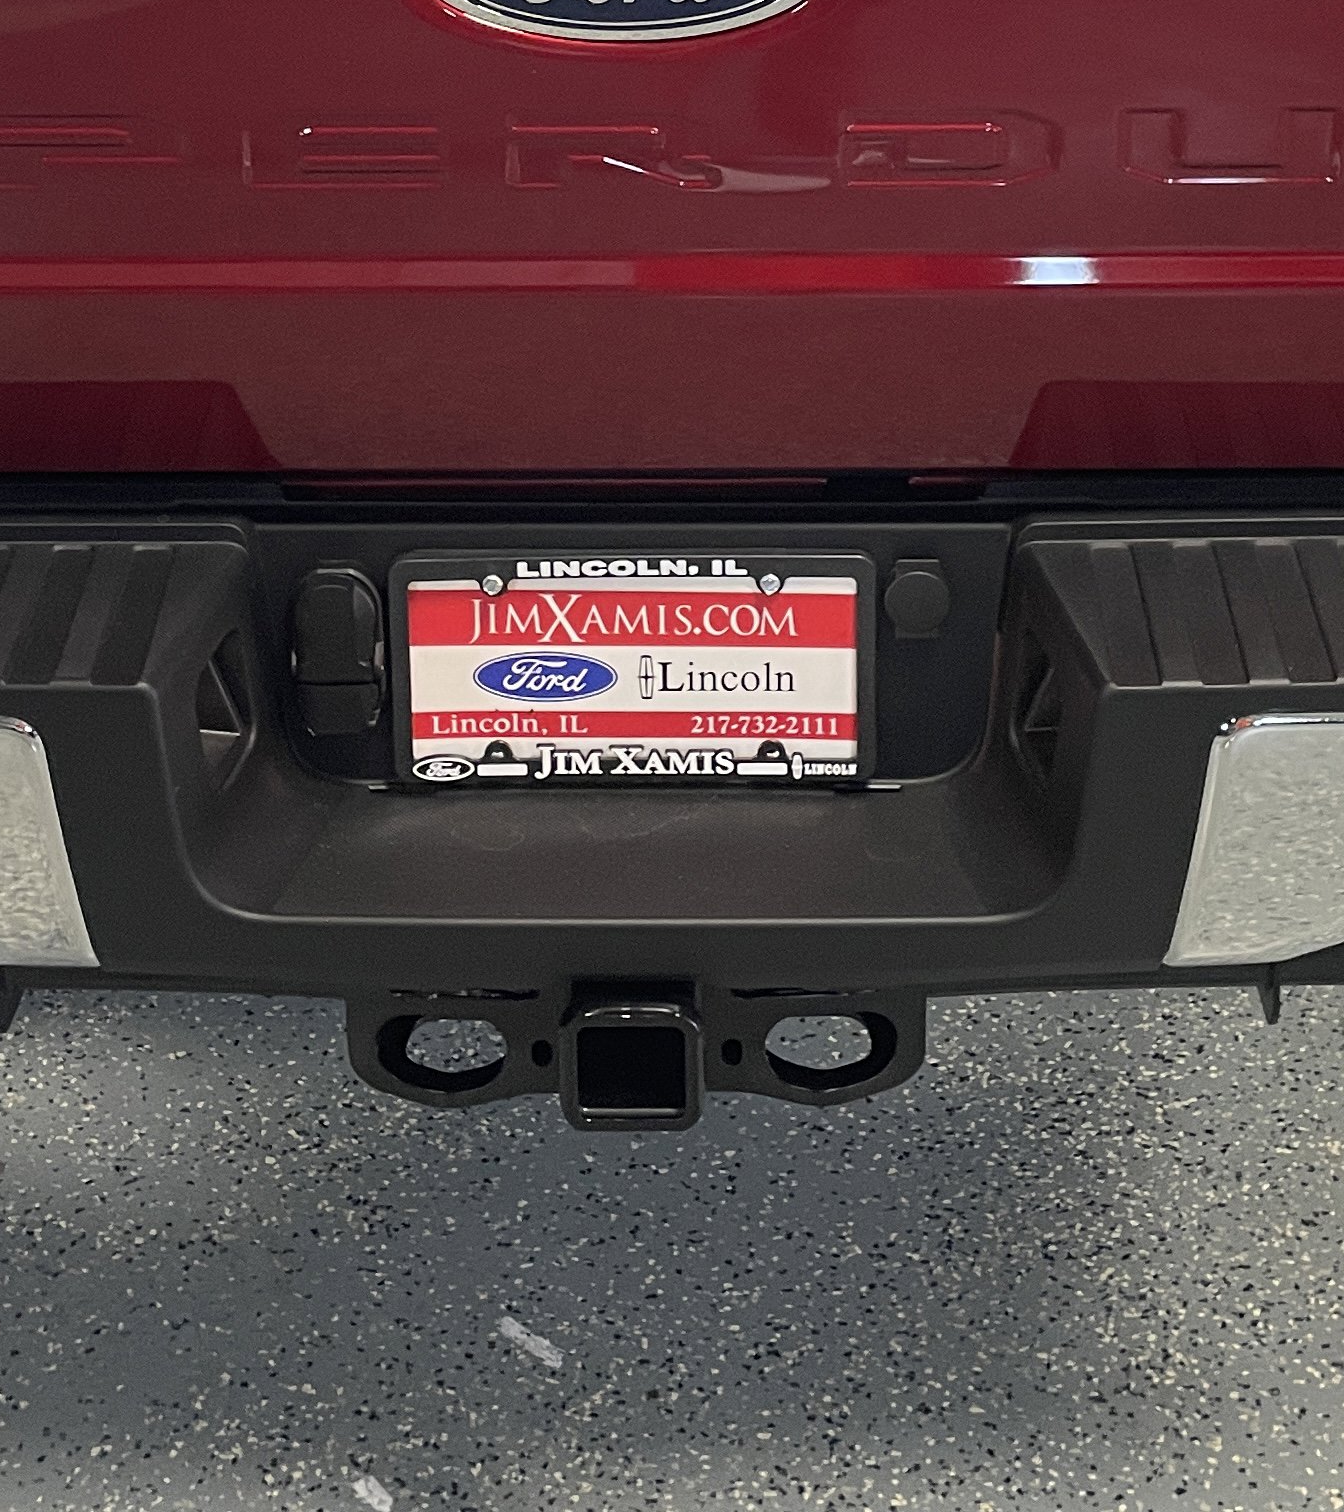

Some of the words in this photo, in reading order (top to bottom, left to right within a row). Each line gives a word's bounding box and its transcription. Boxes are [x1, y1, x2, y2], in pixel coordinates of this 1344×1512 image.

[711, 559, 749, 576] IL
[502, 658, 587, 693] Ford
[657, 661, 795, 694] Lincoln
[431, 714, 548, 736] Lincoln,
[559, 716, 589, 734] IL
[690, 715, 839, 736] 217-732-2111
[426, 762, 462, 777] Ford
[534, 744, 604, 780] JIM
[610, 747, 736, 776] XAMIS
[803, 763, 858, 776] LINCOLN
